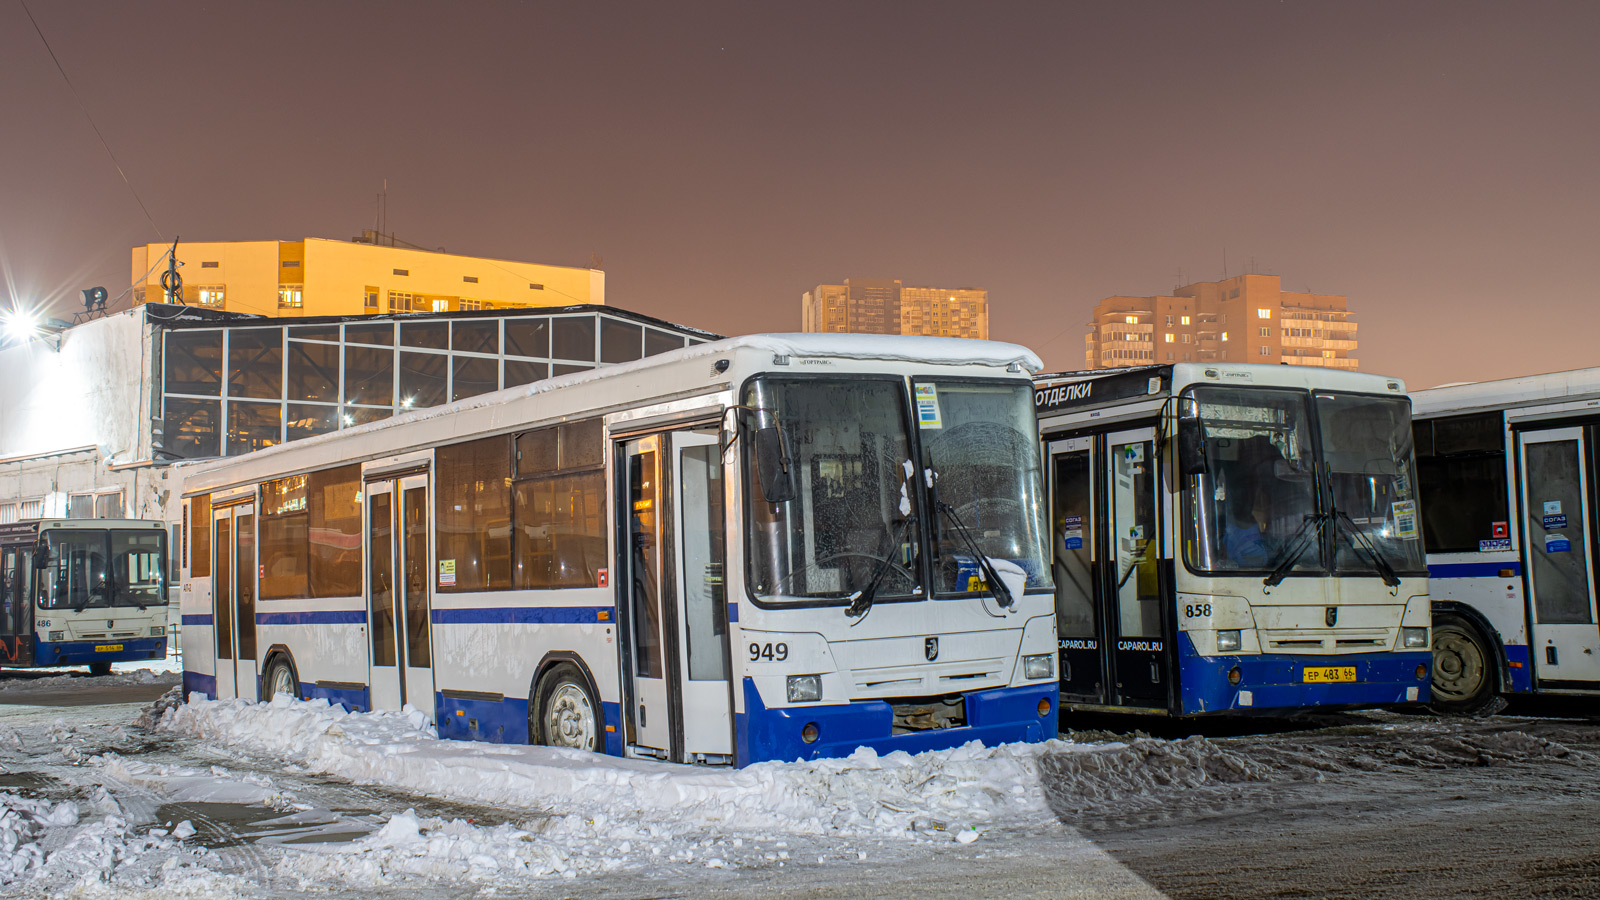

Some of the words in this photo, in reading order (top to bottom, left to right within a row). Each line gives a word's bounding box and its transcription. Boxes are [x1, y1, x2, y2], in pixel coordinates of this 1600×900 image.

[1035, 382, 1093, 407] ОТДЕЛКИ
[1185, 604, 1212, 618] 858
[36, 619, 51, 628] 486
[1058, 639, 1098, 650] CAPAROL.RU
[1117, 640, 1163, 651] CAPAROL.RU
[749, 642, 789, 662] 949
[1323, 669, 1339, 680] 483
[1343, 668, 1353, 677] 66
